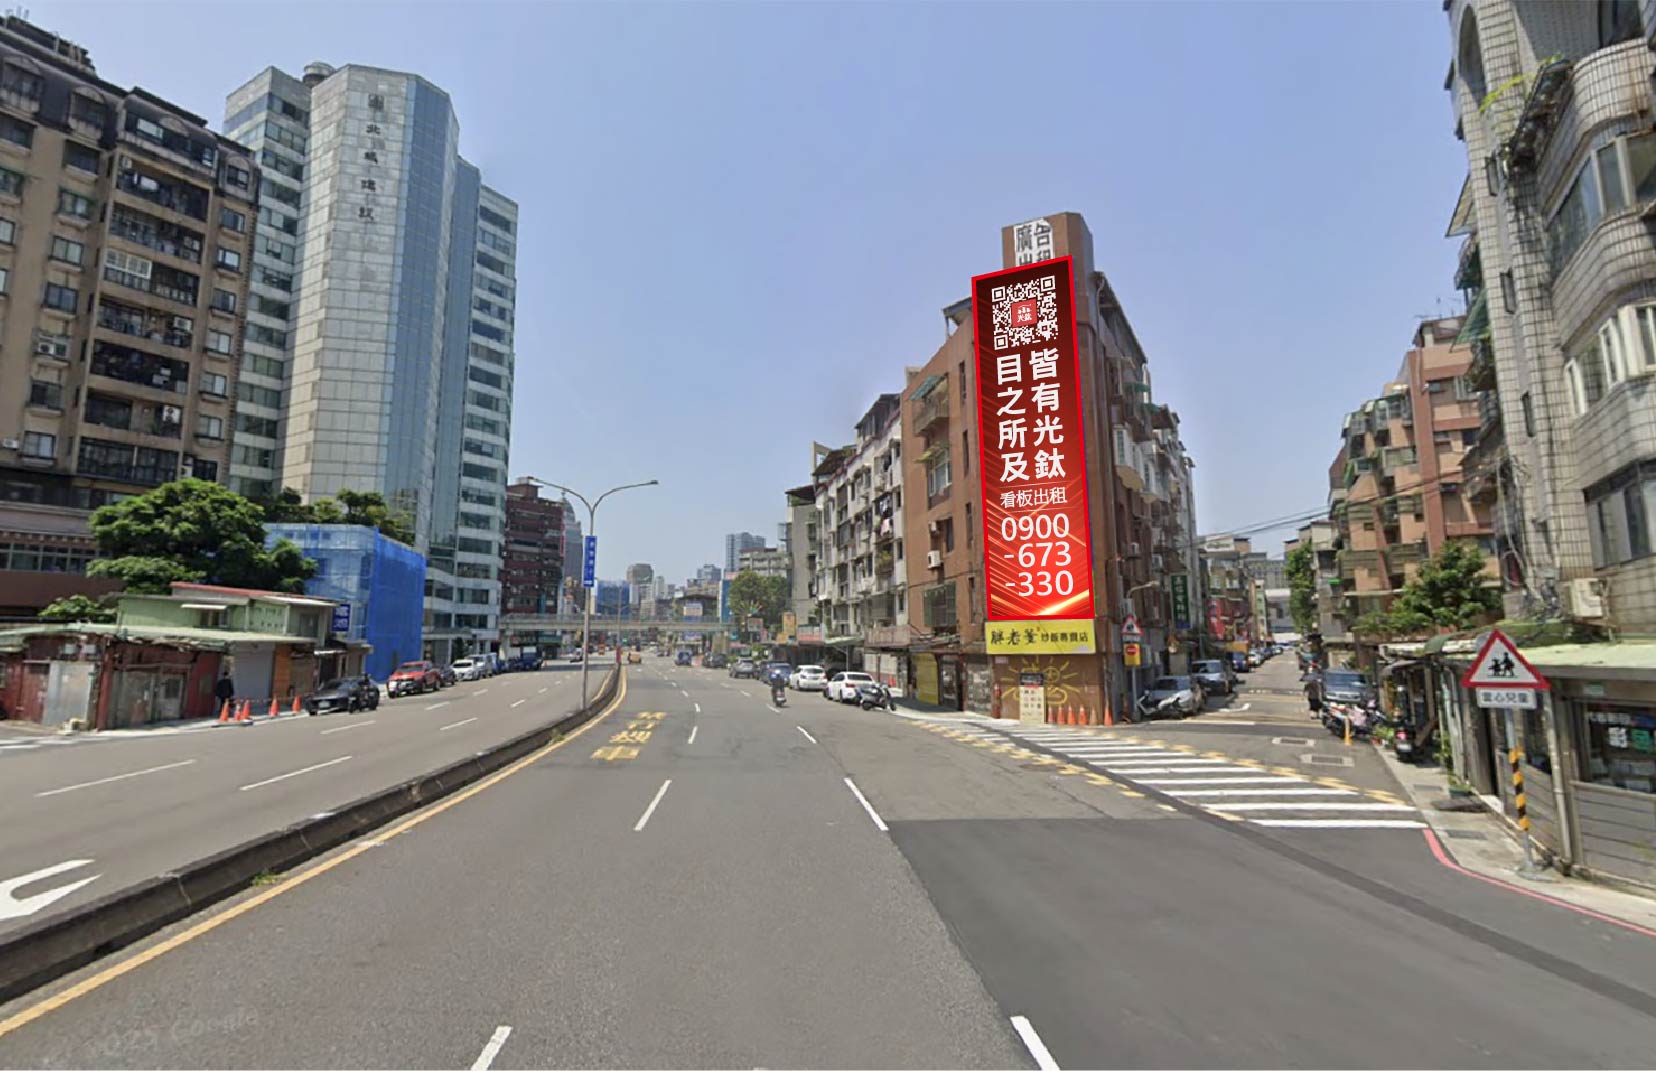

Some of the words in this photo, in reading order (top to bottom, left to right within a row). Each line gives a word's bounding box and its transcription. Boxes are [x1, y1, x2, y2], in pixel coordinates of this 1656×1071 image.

[997, 354, 1030, 482] 目之所及
[1028, 348, 1066, 479] 皆有光鈦
[1000, 486, 1067, 509] 看板出租
[1001, 513, 1070, 541] 0900
[1004, 541, 1072, 568] -673
[1005, 570, 1074, 597] -330
